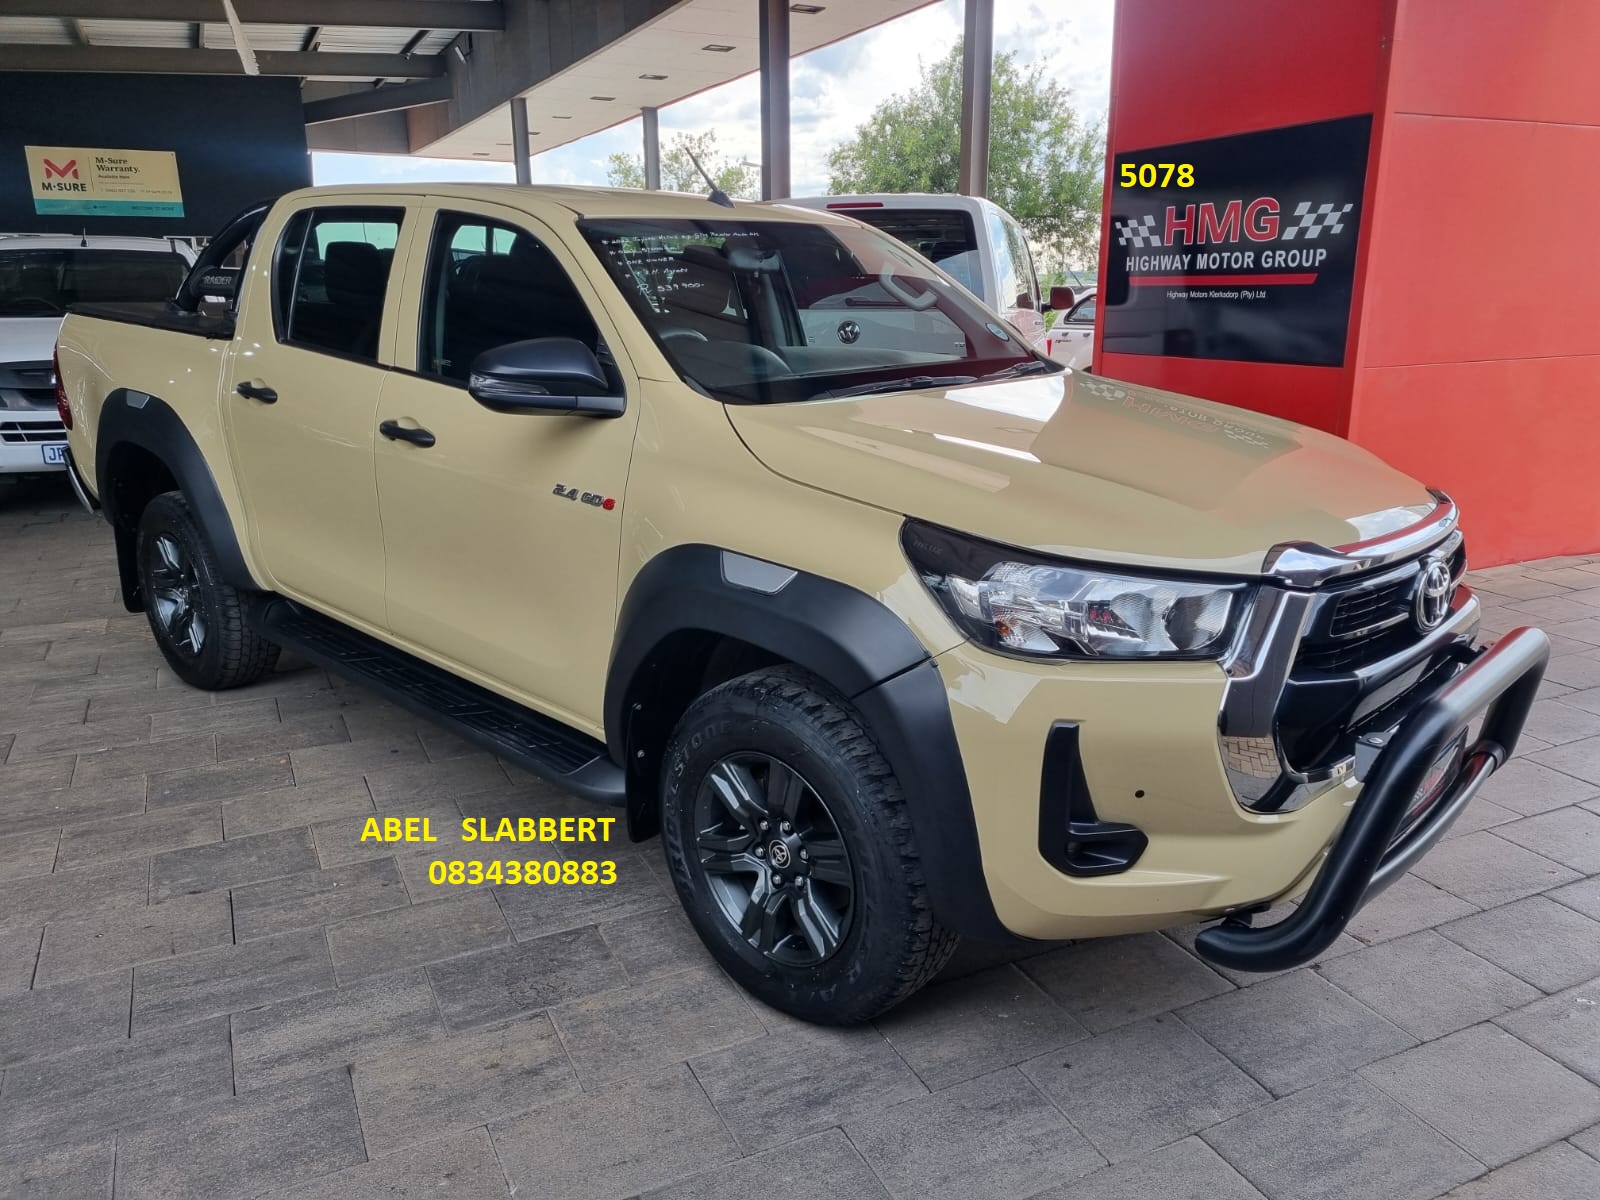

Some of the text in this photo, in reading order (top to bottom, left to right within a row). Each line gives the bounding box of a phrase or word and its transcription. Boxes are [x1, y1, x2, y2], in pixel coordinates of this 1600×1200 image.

[95, 156, 128, 164] M-Sure
[1163, 196, 1280, 246] HMG
[1125, 248, 1327, 272] HIGHWAY MOTOR GROUP
[1166, 290, 1188, 300] Highway
[1189, 290, 1208, 298] Motors
[1240, 290, 1254, 300] (Pty)
[1256, 290, 1266, 298] Ltd
